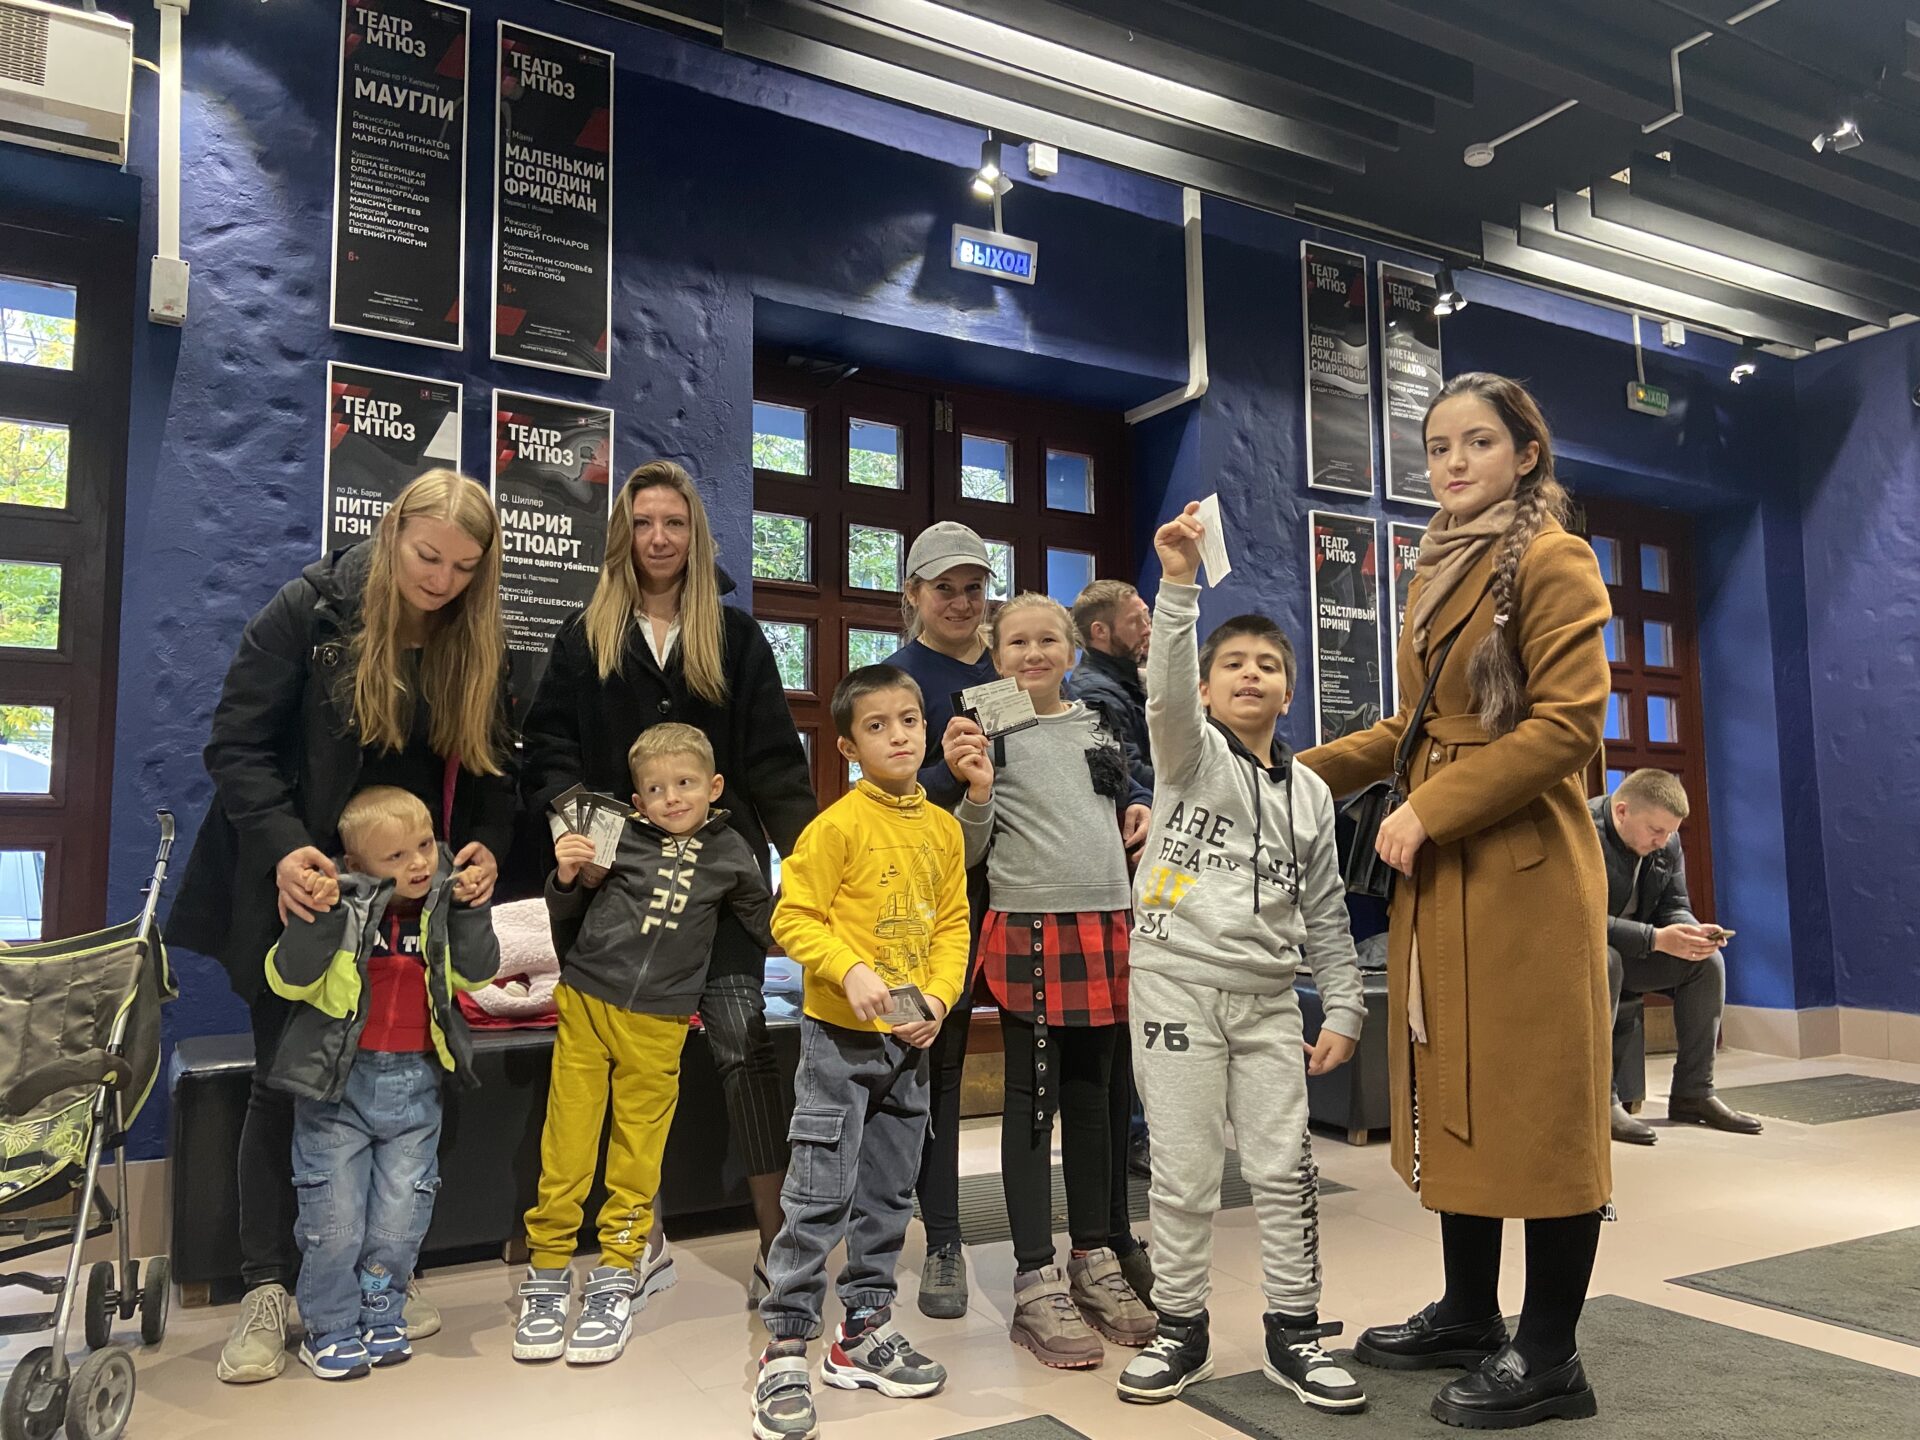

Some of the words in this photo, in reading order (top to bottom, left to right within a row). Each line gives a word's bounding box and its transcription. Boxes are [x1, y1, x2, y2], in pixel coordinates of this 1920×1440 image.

[355, 7, 413, 36] ТЕАТР
[366, 27, 427, 58] МТЮЗ
[511, 51, 562, 78] ТЕАТР
[521, 71, 575, 99] МТЮЗ
[354, 77, 454, 121] МАУГЛИ
[352, 110, 400, 128] Режиссёры
[352, 121, 404, 139] ВЯЧЕСЛАВ
[406, 133, 450, 150] ИГНАТОВ
[352, 132, 387, 146] МАРИЯ
[389, 138, 450, 160] ЛИТВИНОВА
[351, 157, 378, 168] ЕЛЕНА
[379, 162, 426, 179] БЕКРИЦКАЯ
[505, 142, 604, 181] МАЛЕНЬКИЙ
[350, 165, 377, 176] ОЛЬГА
[378, 171, 426, 187] БЕКРИЦКАЯ
[505, 160, 591, 194] ГОСПОДИН
[349, 188, 392, 203] Композитор
[350, 180, 373, 191] ИВАН
[375, 184, 430, 203] ВИНОГРАДОВ
[504, 177, 597, 213] ФРИДЕМАН
[349, 196, 386, 209] МАКСИМ
[387, 203, 421, 216] СЕРГЕЕВ
[349, 203, 389, 218] Хореограф
[349, 211, 386, 224] МИХАИЛ
[387, 218, 429, 233] КОЛЛЕГОВ
[349, 219, 396, 234] Постановщик
[504, 216, 542, 233] Режиссёр
[348, 226, 386, 240] ЕВГЕНИЙ
[387, 234, 427, 248] ГУЛЮГИН
[504, 226, 540, 240] АНДРЕЙ
[542, 234, 589, 251] ГОНЧАРОВ
[503, 249, 553, 265] КОНСТАНТИН
[554, 260, 593, 274] СОЛОВЬЁВ
[961, 240, 1028, 275] ВЫХОД
[502, 264, 537, 277] АЛЕКСЕЙ
[538, 271, 566, 283] ПОПОВ
[1310, 262, 1339, 280] ТЕАТР
[1316, 277, 1347, 295] МТЮЗ
[1387, 282, 1414, 298] ТЕАТР
[1392, 296, 1421, 312] МТЮЗ
[1310, 334, 1335, 349] ДЕНЬ
[1311, 347, 1360, 368] РОЖДЕНИЯ
[1388, 347, 1438, 368] УЛЕТАЮЩИЙ
[1311, 359, 1366, 381] СМИРНОВОЙ
[1389, 359, 1427, 378] МОНАХОВ
[342, 395, 402, 421] ТЕАТР
[1643, 389, 1669, 410] ЫХОД
[354, 415, 416, 442] МТЮЗ
[508, 423, 562, 447] ТЕАТР
[518, 442, 574, 466] МТЮЗ
[336, 486, 346, 494] по
[346, 487, 359, 496] Дж.
[360, 488, 382, 498] Барри
[500, 493, 509, 503] Ф.
[511, 494, 544, 508] Шиллер
[335, 496, 393, 517] ПИТЕР
[334, 516, 372, 536] ПЭН
[500, 507, 573, 536] МАРИЯ
[501, 530, 582, 559] СТЮАРТ
[1320, 535, 1349, 550] ТЕАТР
[1398, 544, 1420, 559] ТЕАТ
[534, 558, 562, 569] одного
[564, 561, 600, 573] убийства
[1326, 549, 1356, 564] МТЮЗ
[1404, 559, 1416, 571] МТ
[498, 585, 534, 596] Режиссёр
[498, 593, 519, 601] ПЁТР
[520, 594, 585, 608] ШЕРЕШЕВСКИЙ
[530, 616, 564, 625] ЛОПАРДИН
[1320, 604, 1376, 621] СЧАСТЛИВЫЙ
[1320, 618, 1351, 633] ПРИНЦ
[525, 645, 549, 653] ПОПОВ
[1165, 801, 1234, 848] ARE
[1144, 1021, 1190, 1051] 96
